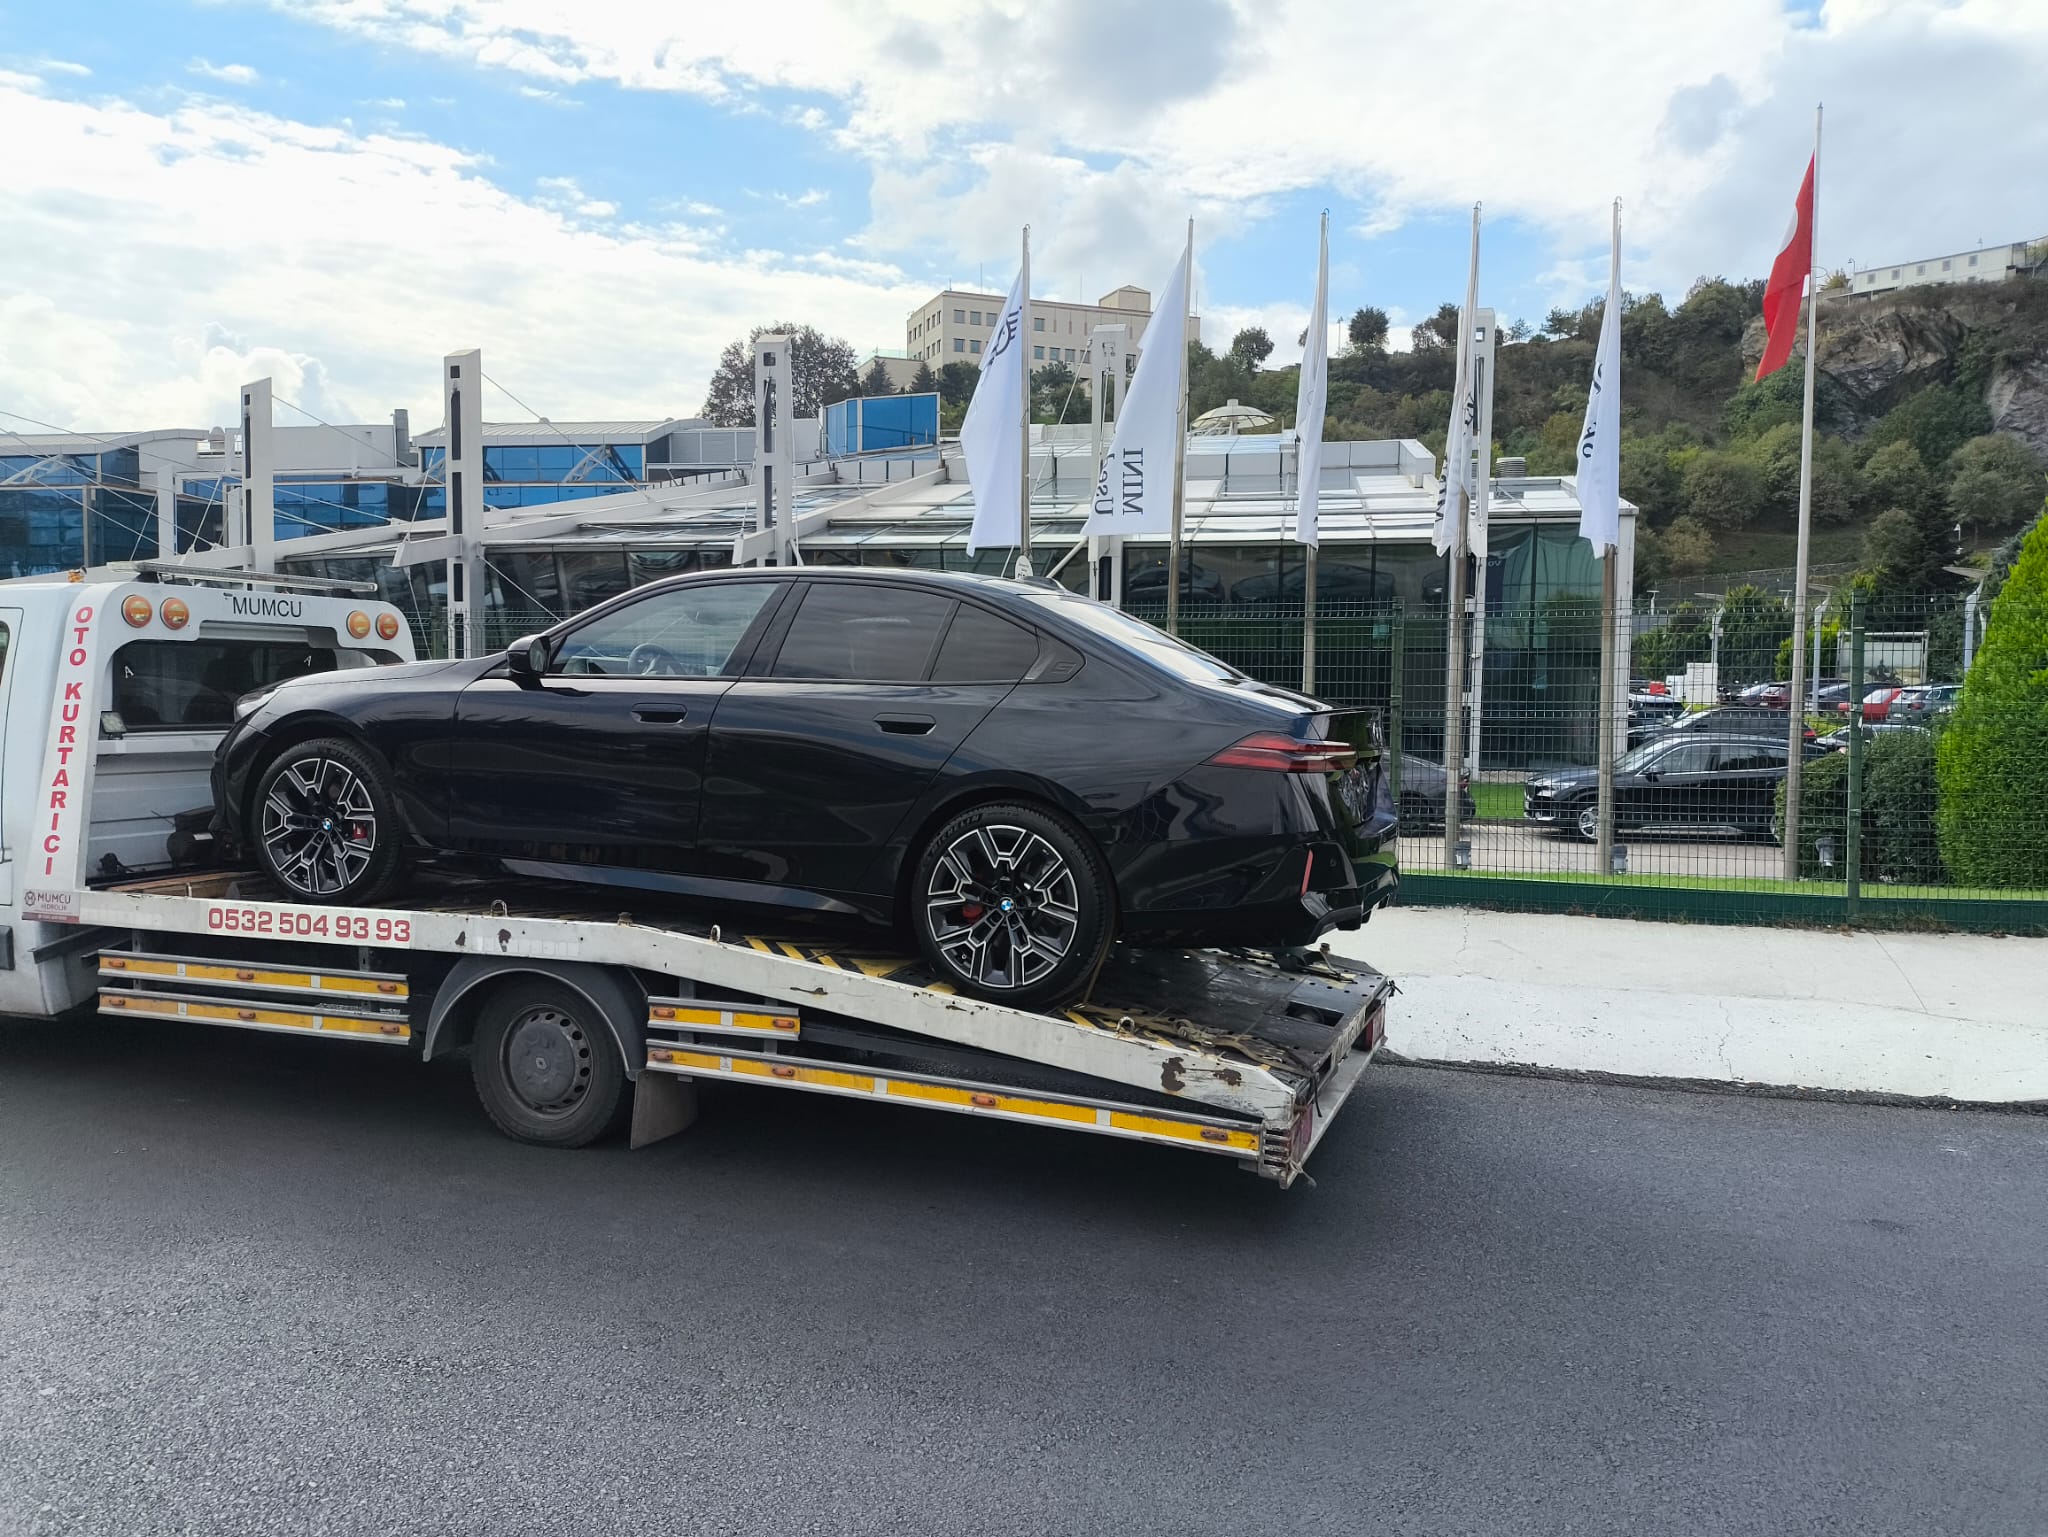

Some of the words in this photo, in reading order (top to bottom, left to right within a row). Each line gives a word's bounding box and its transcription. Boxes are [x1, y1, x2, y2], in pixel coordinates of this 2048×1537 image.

[232, 596, 302, 618] MUMCU
[69, 606, 93, 666] OTO
[43, 682, 83, 876] KURTARICI
[37, 892, 71, 904] MUMCU
[208, 907, 273, 933] 0532
[279, 912, 329, 937] 504
[335, 915, 369, 939] 93
[376, 918, 411, 942] 93
